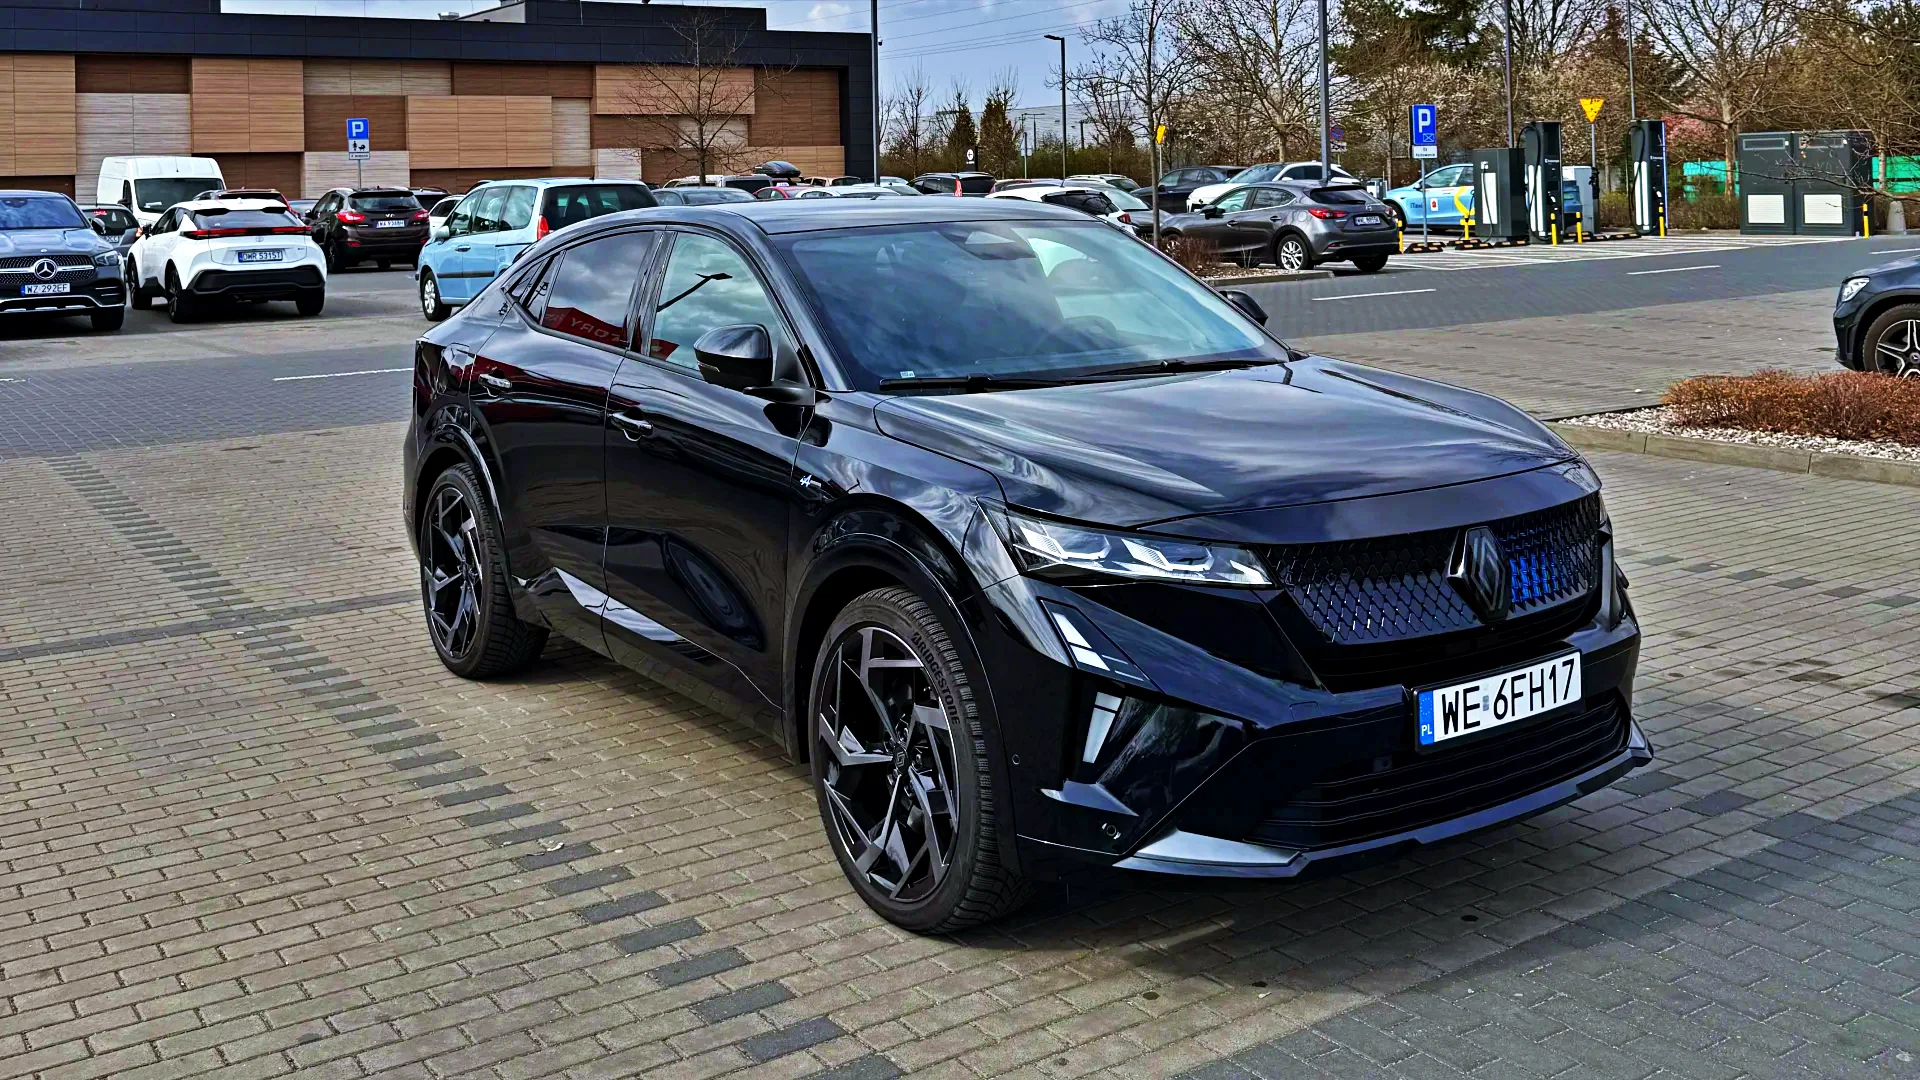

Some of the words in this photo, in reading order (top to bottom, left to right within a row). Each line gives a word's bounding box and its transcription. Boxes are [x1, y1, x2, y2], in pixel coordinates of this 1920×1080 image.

[351, 121, 364, 137] P
[1418, 108, 1430, 133] P
[911, 631, 961, 725] BRIDGESTONE
[1441, 685, 1481, 735] WE
[1493, 657, 1575, 721] 6FH17
[1421, 723, 1433, 737] PL
